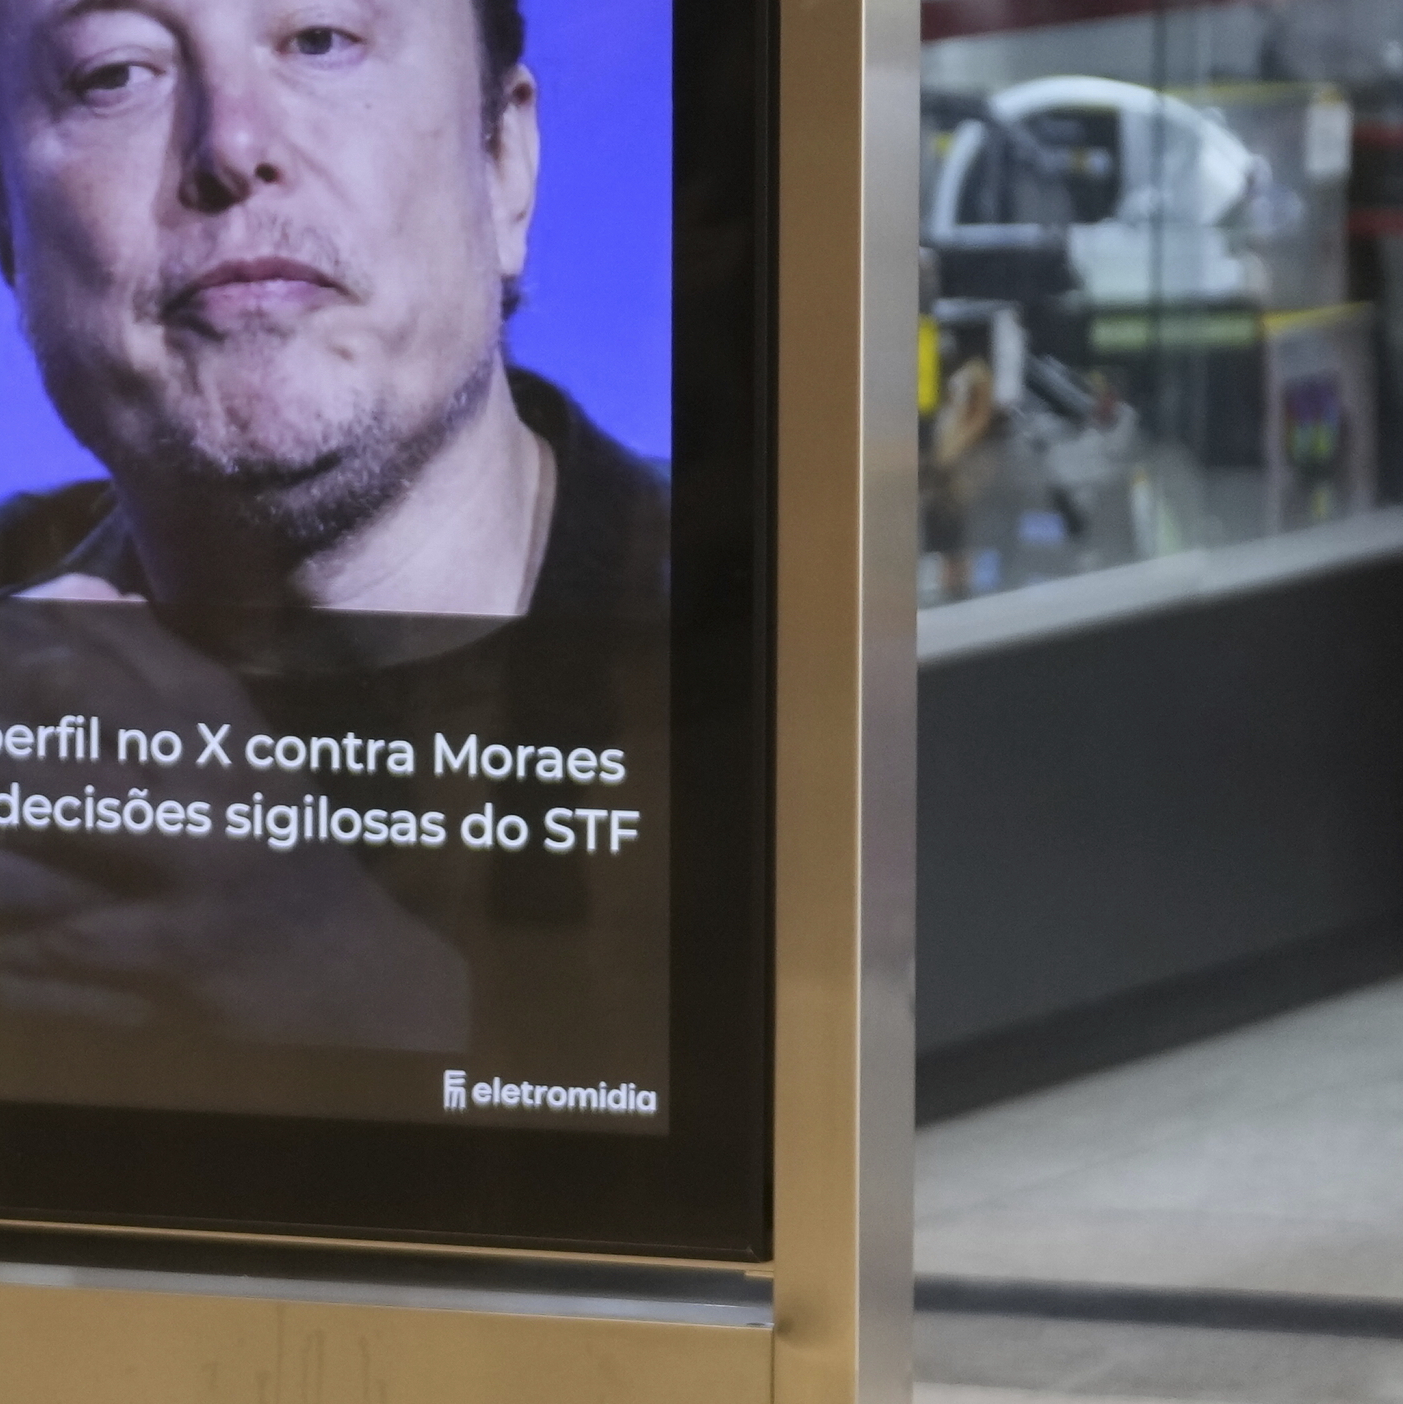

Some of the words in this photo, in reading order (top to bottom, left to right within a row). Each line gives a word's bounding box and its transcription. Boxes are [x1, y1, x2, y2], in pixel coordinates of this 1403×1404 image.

[117, 728, 184, 767] no
[195, 722, 233, 769] X
[244, 731, 415, 777] contra
[434, 732, 626, 785] Moraes
[224, 791, 447, 851] sigilosas
[460, 802, 529, 851] do
[543, 807, 641, 855] STF
[471, 1076, 658, 1114] eletromidia
